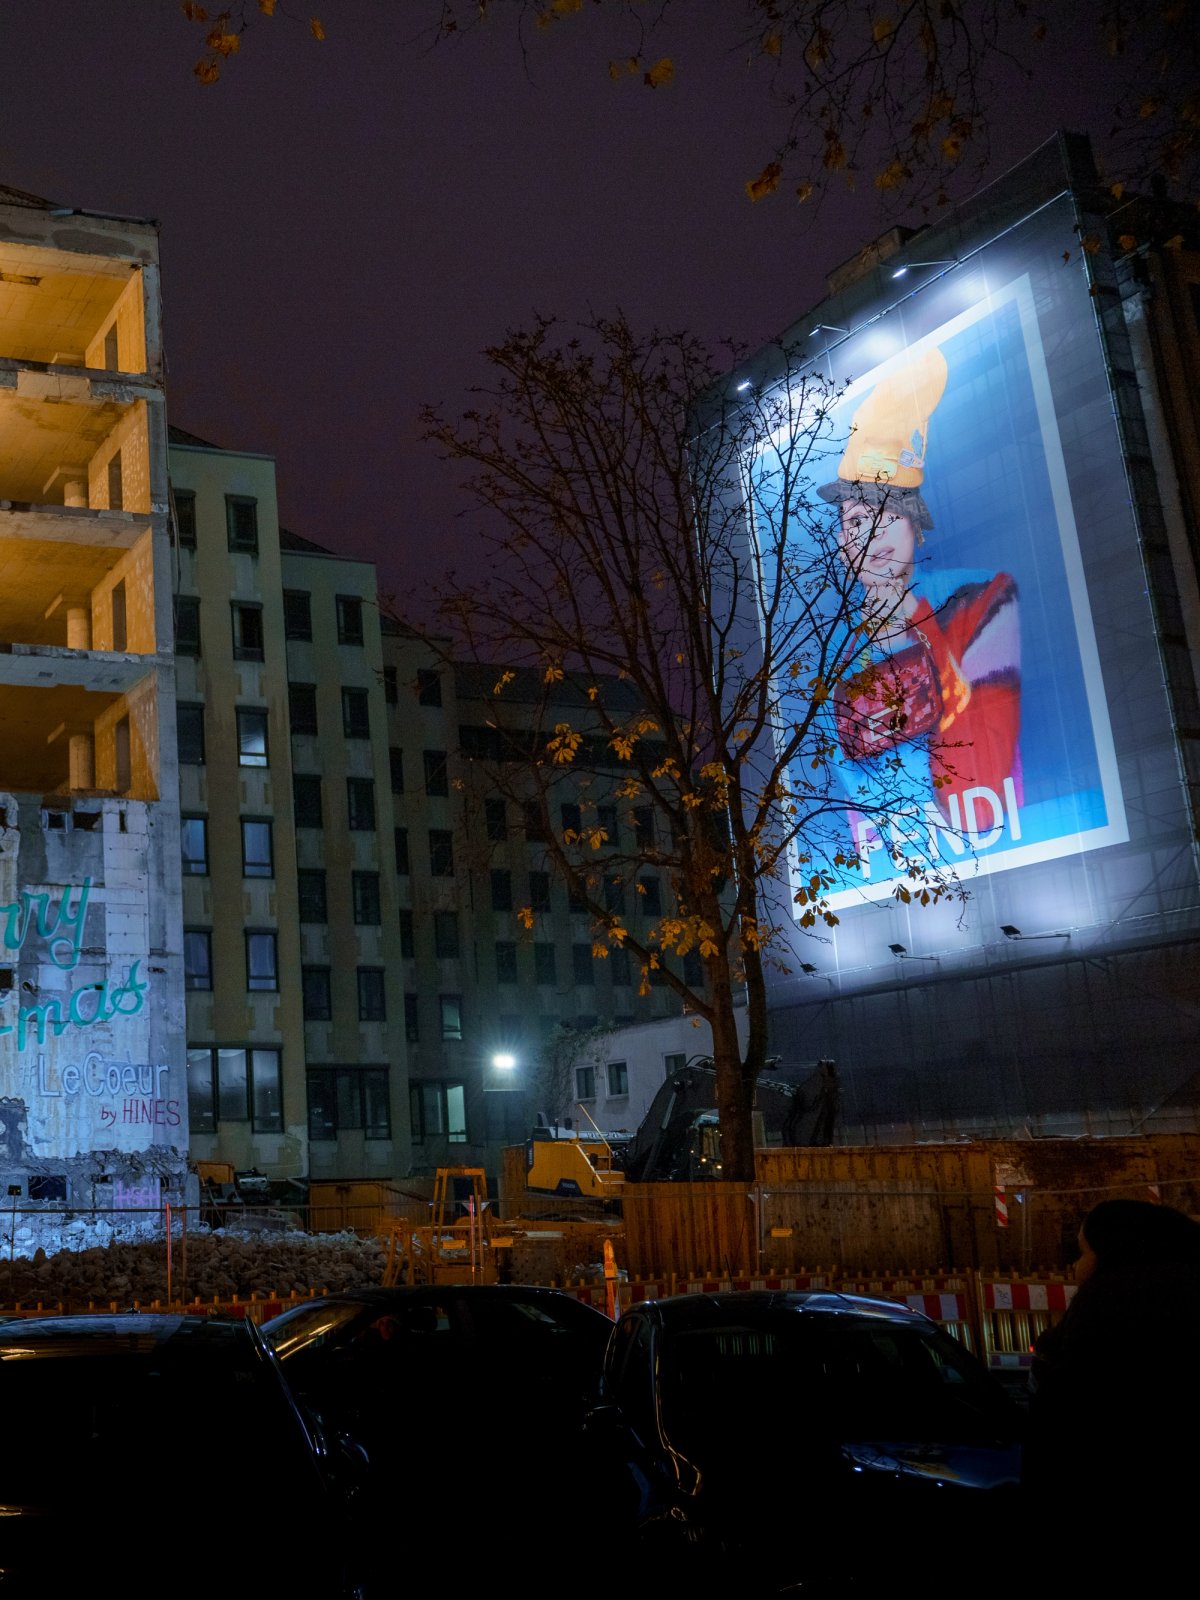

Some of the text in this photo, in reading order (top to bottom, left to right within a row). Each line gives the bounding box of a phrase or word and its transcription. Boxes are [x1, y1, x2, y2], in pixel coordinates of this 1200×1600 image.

[857, 776, 1022, 879] FENDI
[101, 1099, 181, 1127] by HINES
